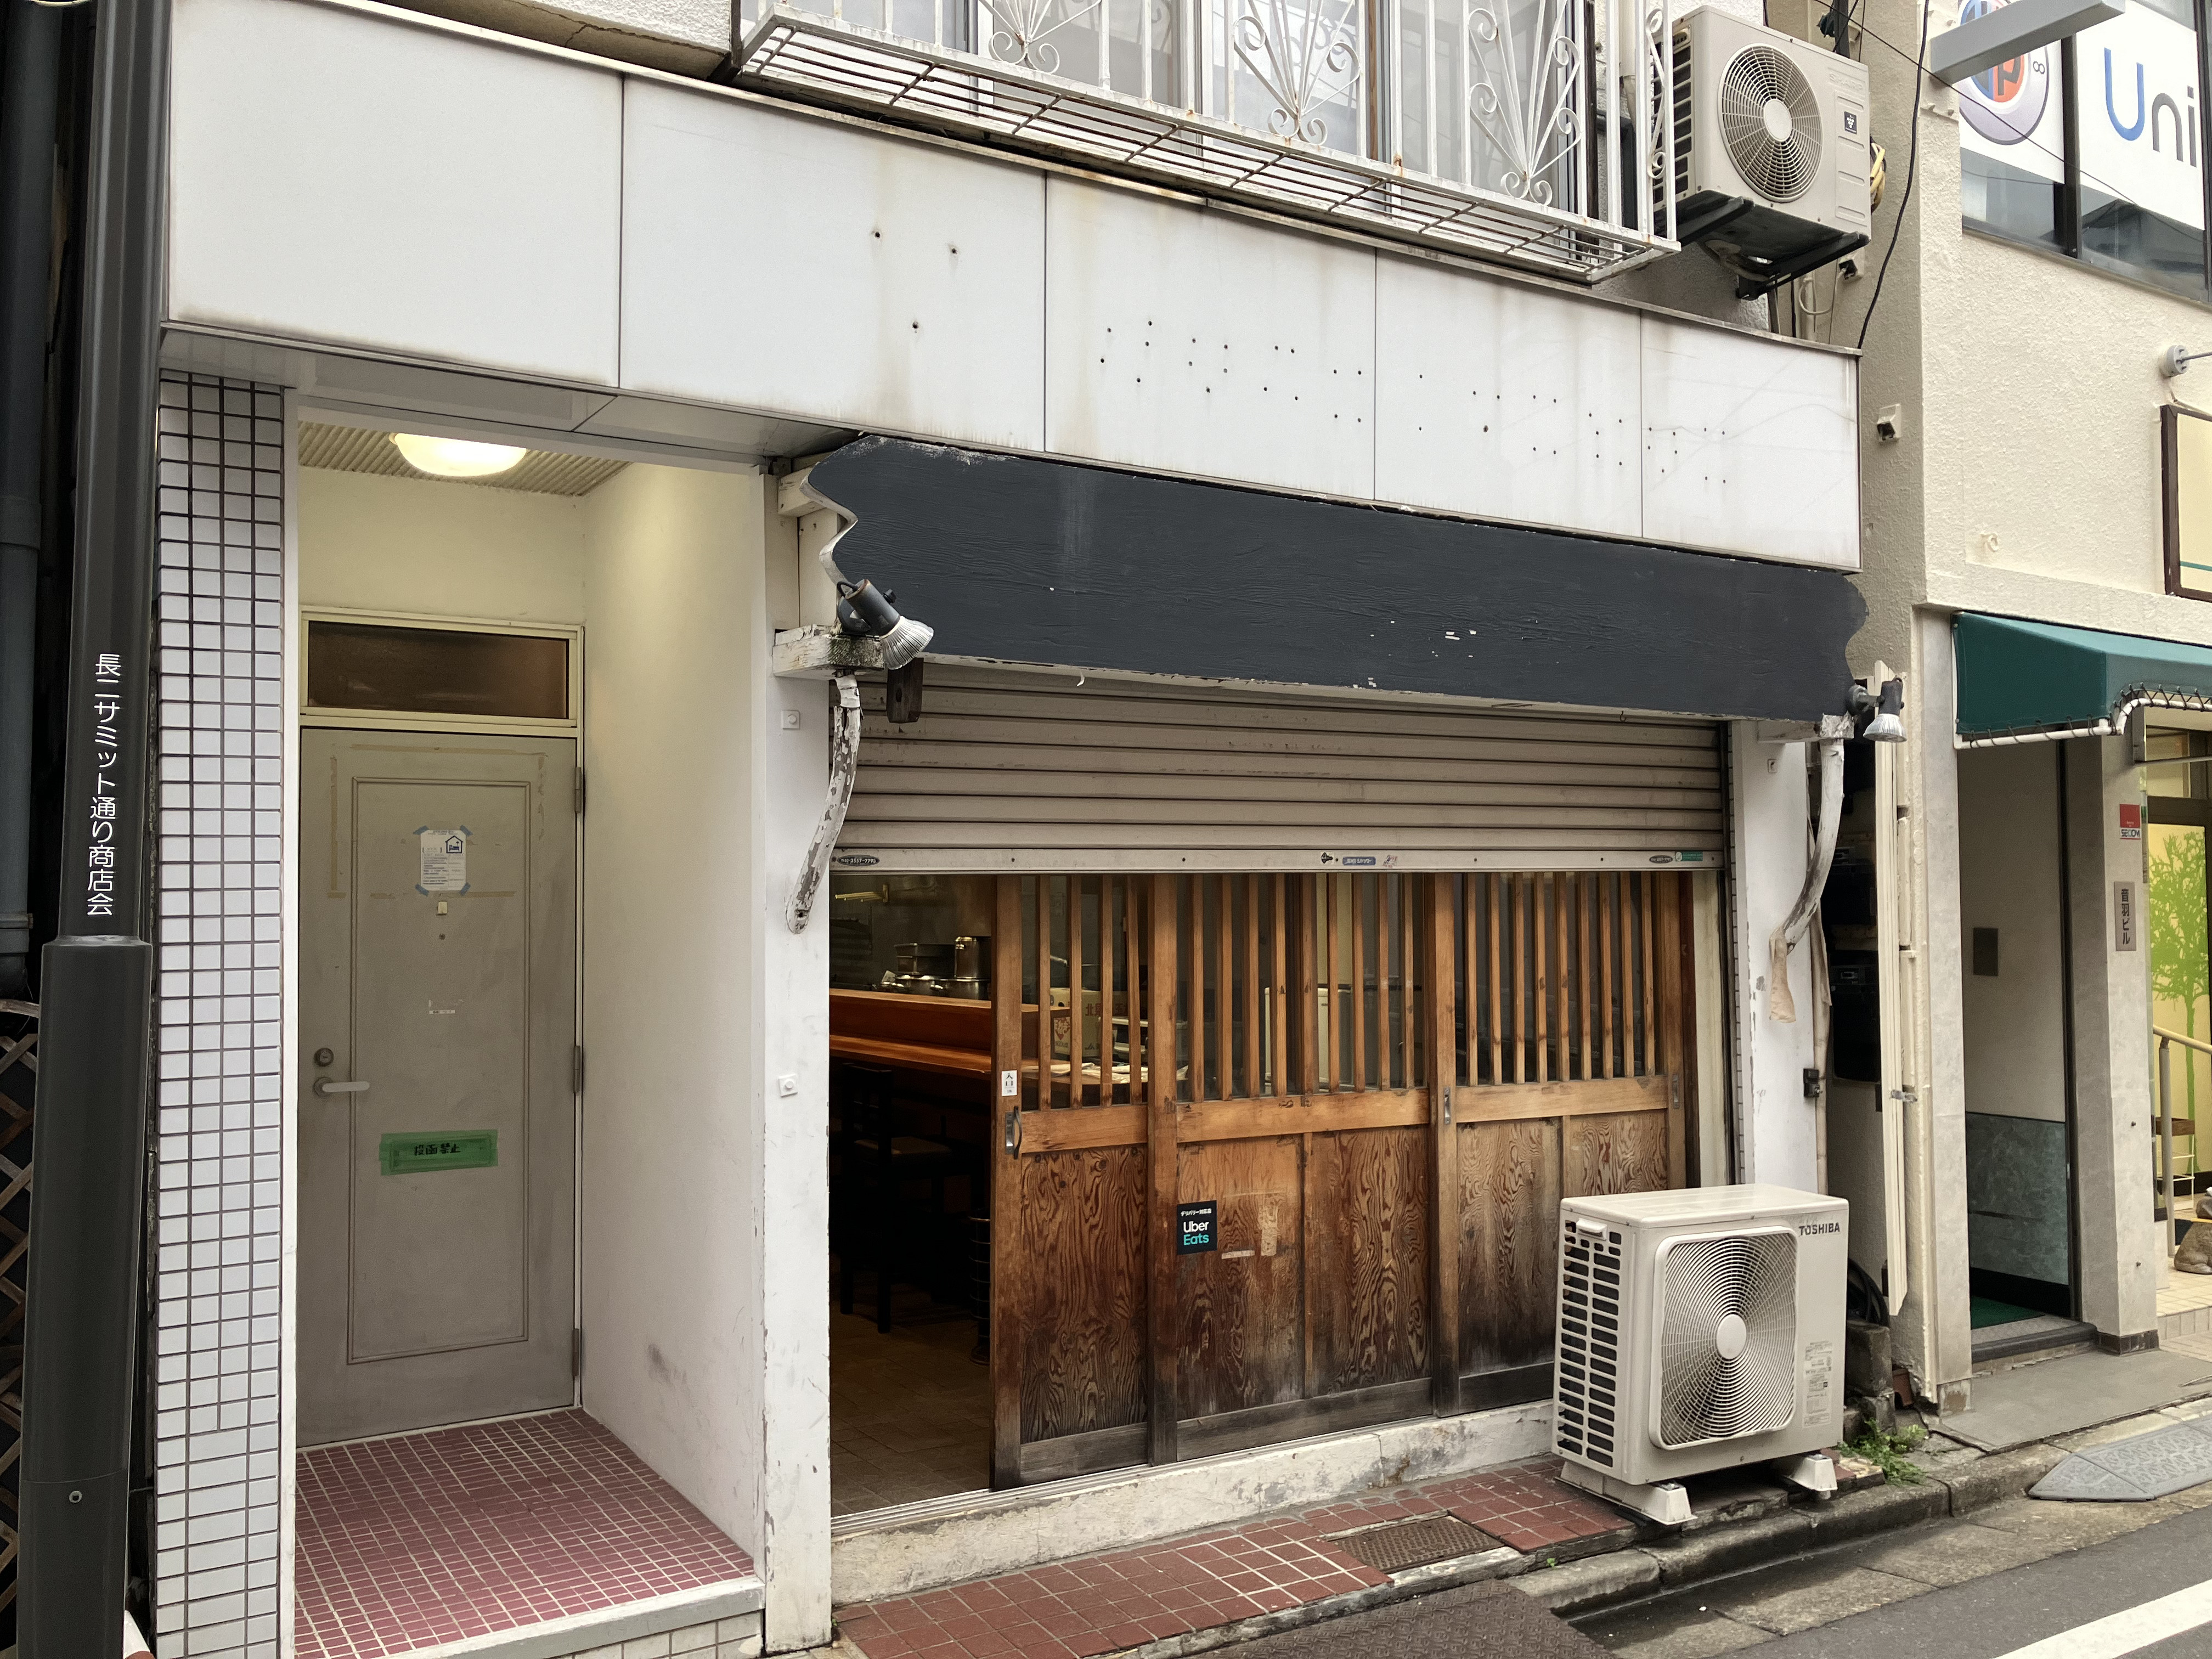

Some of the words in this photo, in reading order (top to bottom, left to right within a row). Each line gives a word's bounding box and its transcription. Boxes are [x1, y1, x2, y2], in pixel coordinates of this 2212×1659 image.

[2104, 47, 2197, 168] Uni
[87, 653, 121, 916] 長二サミット通り商店会
[2121, 888, 2131, 945] 音羽ビル
[1005, 1072, 1014, 1086] 入口
[414, 1142, 461, 1156] 投函禁止
[1183, 1221, 1209, 1233] Uber
[1798, 1222, 1840, 1236] TOSHIBA
[1183, 1233, 1210, 1246] Eats
